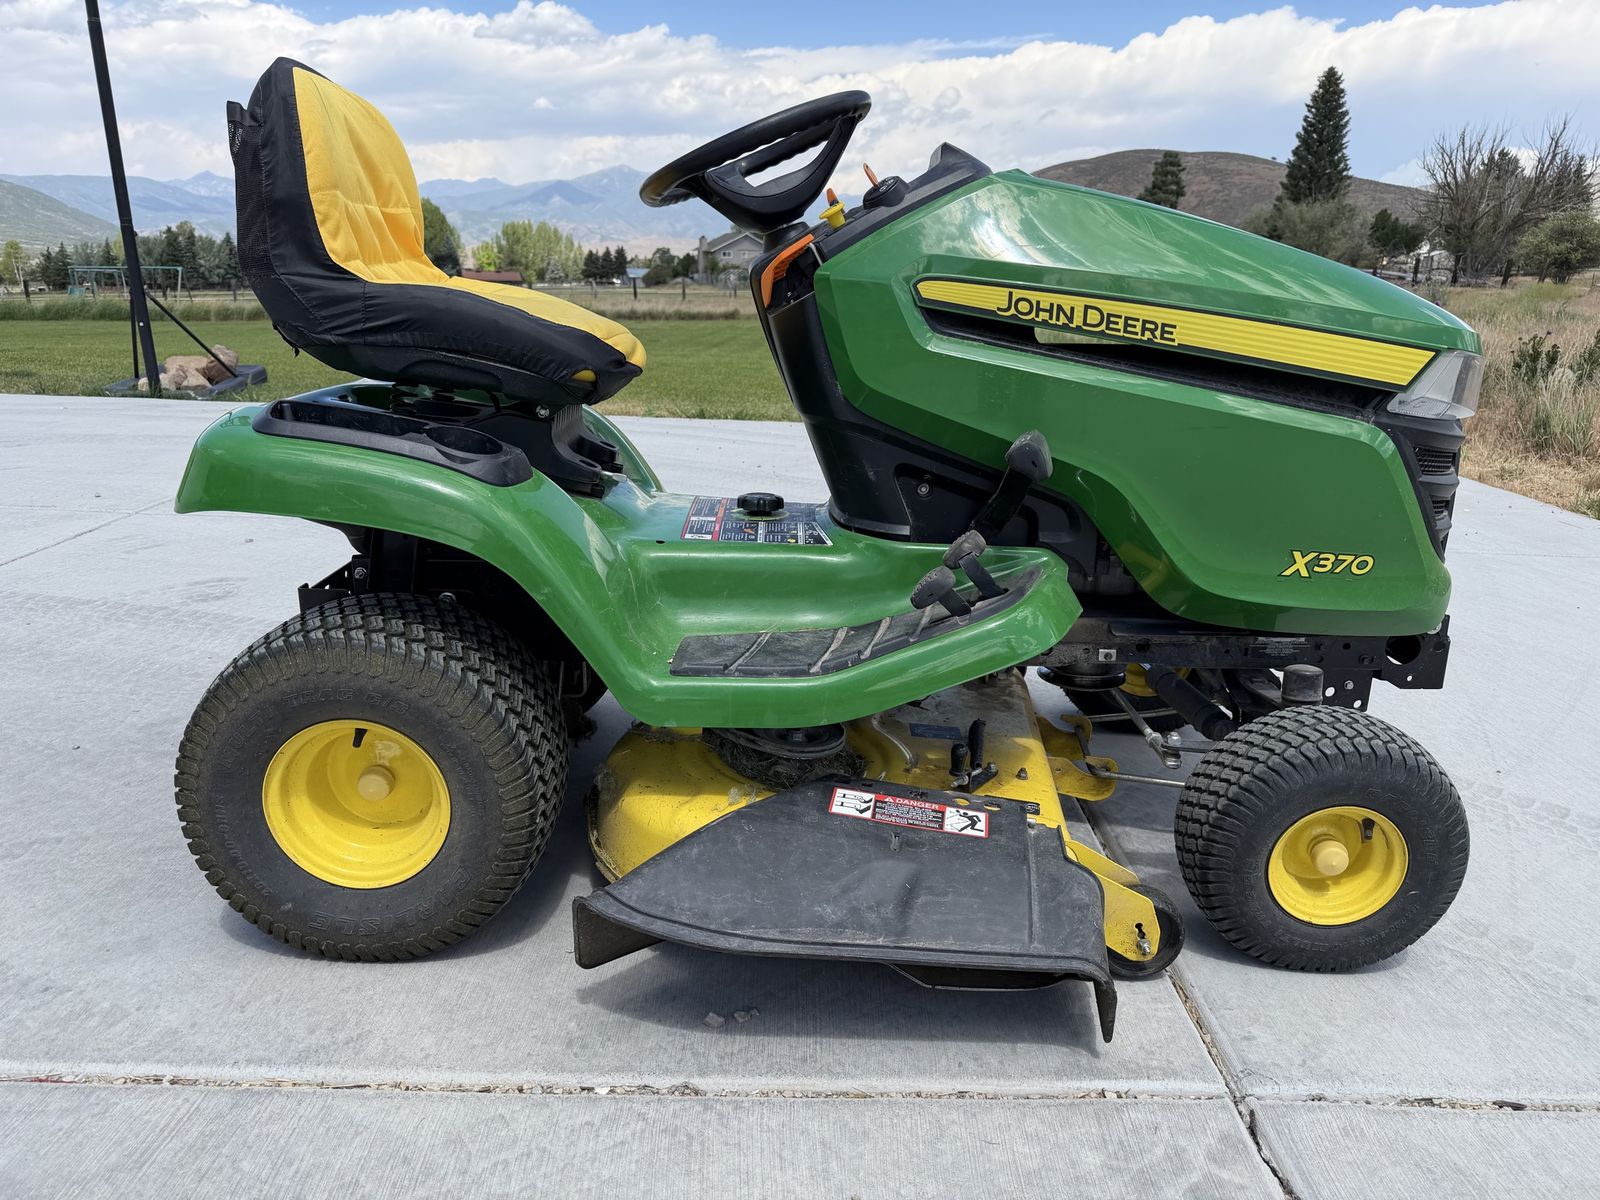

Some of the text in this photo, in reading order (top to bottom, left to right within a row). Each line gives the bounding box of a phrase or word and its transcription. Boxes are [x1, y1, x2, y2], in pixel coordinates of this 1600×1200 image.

[996, 291, 1178, 344] JOHN DEERE
[1278, 549, 1376, 578] X370
[895, 797, 940, 810] DANGER
